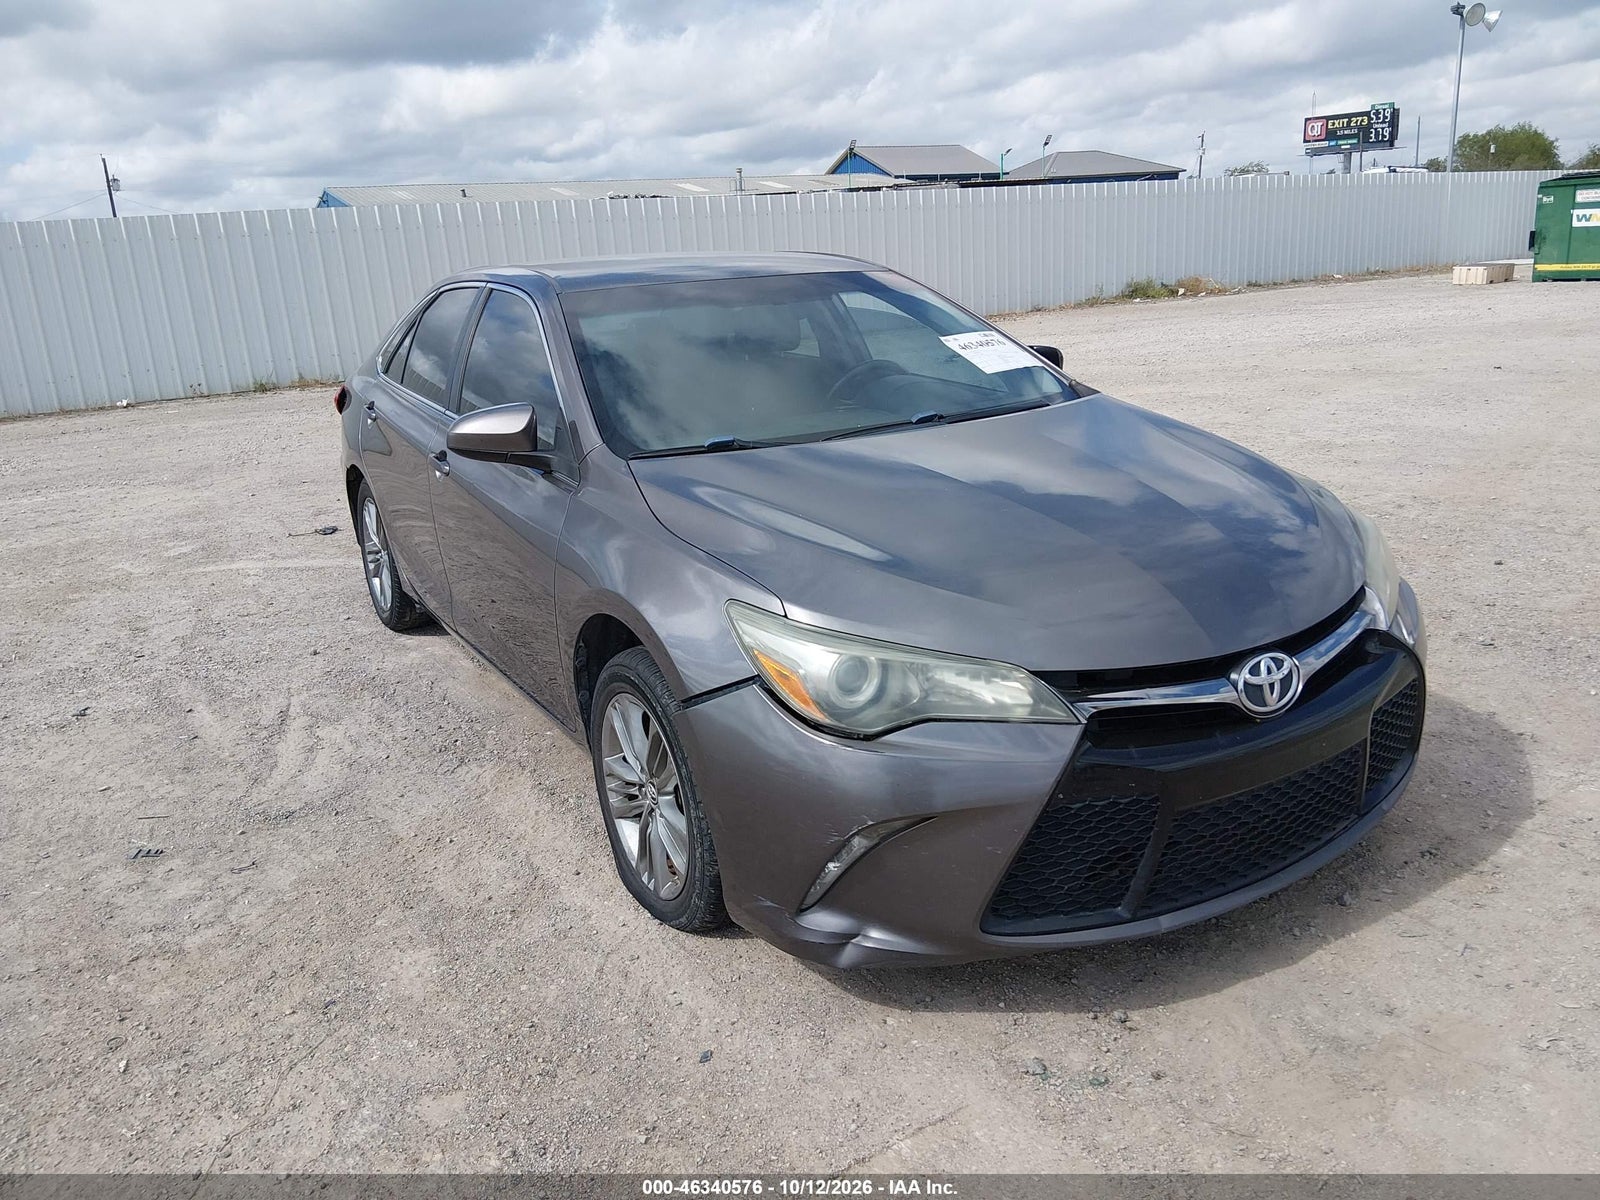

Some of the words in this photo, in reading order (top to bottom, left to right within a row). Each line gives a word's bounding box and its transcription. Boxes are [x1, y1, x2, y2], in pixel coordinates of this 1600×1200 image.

[1328, 119, 1348, 128] EXIT
[1350, 117, 1368, 127] 273
[1308, 122, 1323, 136] QT
